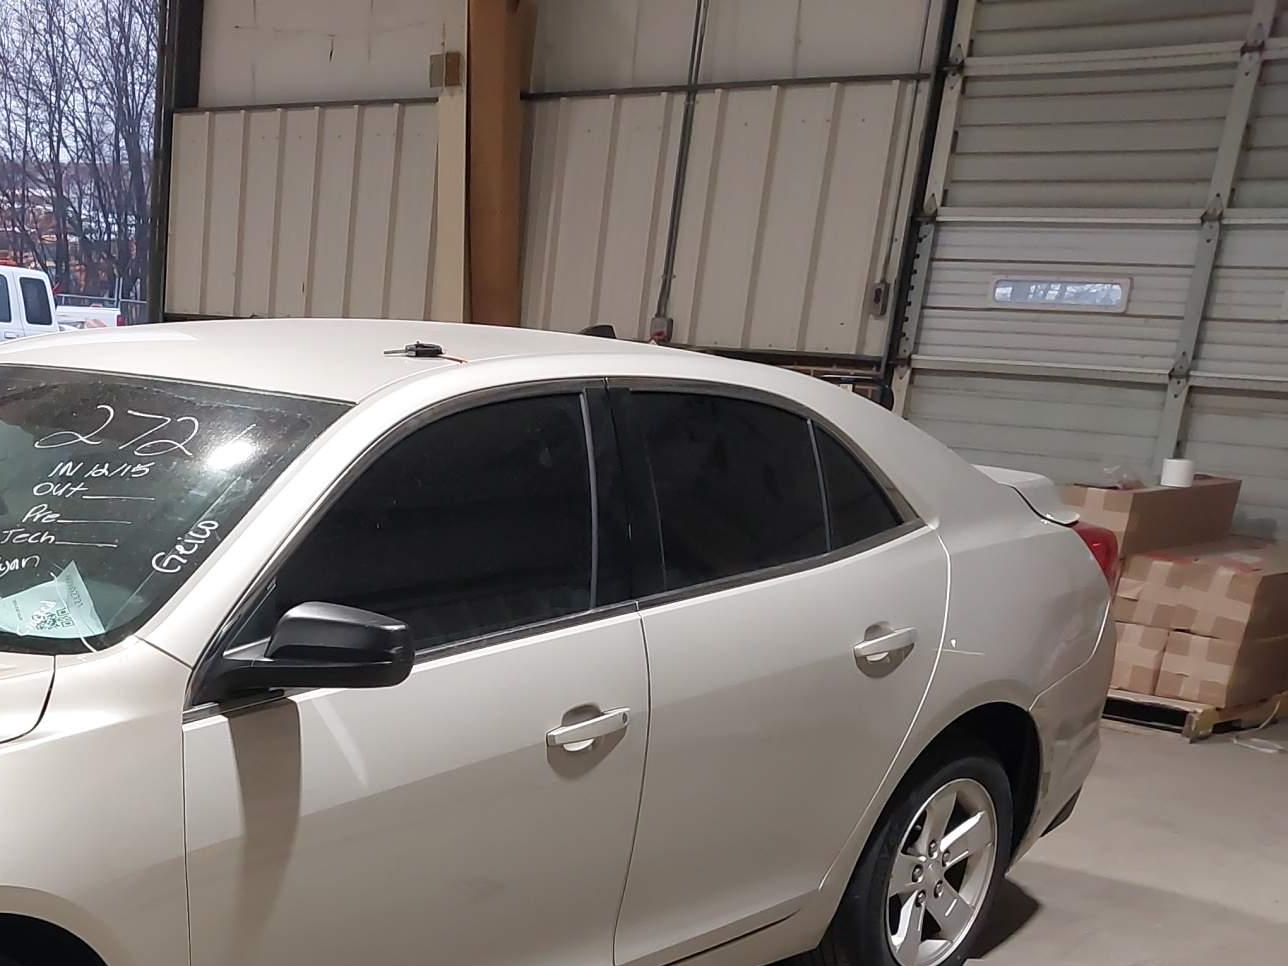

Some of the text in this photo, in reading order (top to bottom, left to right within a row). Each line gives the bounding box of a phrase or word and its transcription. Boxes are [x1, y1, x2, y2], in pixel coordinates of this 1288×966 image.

[34, 404, 199, 456] 272
[47, 461, 84, 478] IN
[21, 503, 61, 523] Pre
[0, 528, 56, 545] Tech
